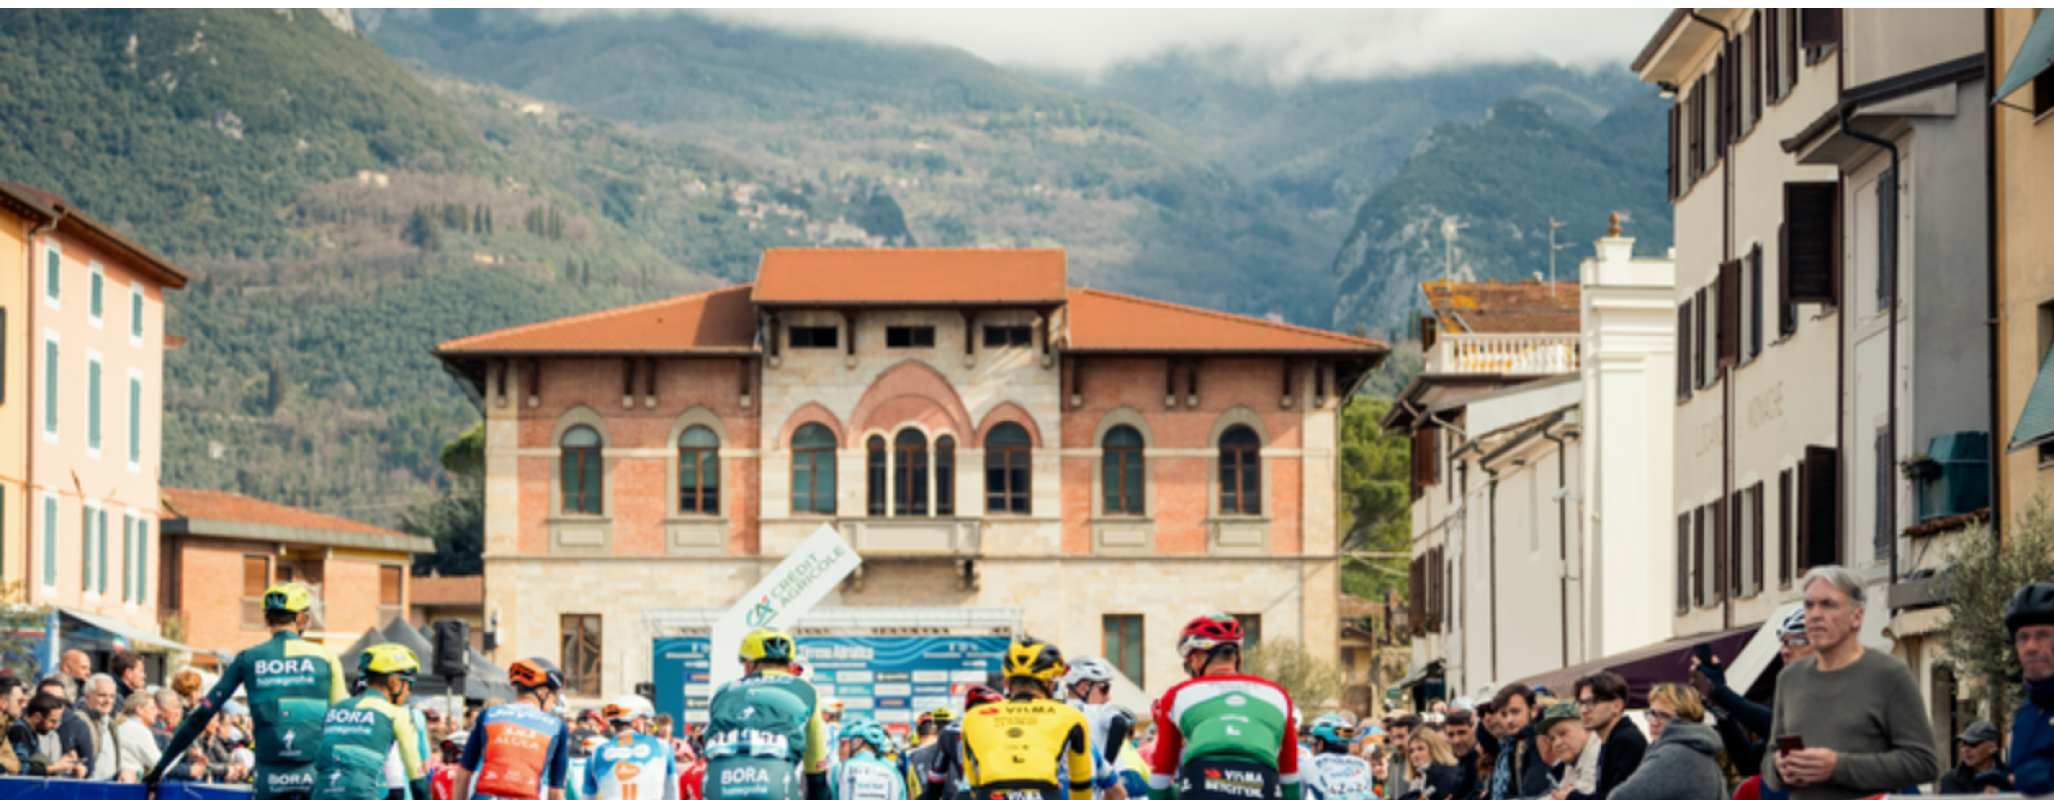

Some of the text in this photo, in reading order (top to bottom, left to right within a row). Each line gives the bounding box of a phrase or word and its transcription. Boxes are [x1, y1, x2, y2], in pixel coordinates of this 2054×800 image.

[780, 545, 846, 608] AGRICOLE
[254, 658, 316, 675] BORA
[326, 708, 375, 724] BORA
[268, 773, 314, 786] BORA
[721, 767, 770, 785] BORA
